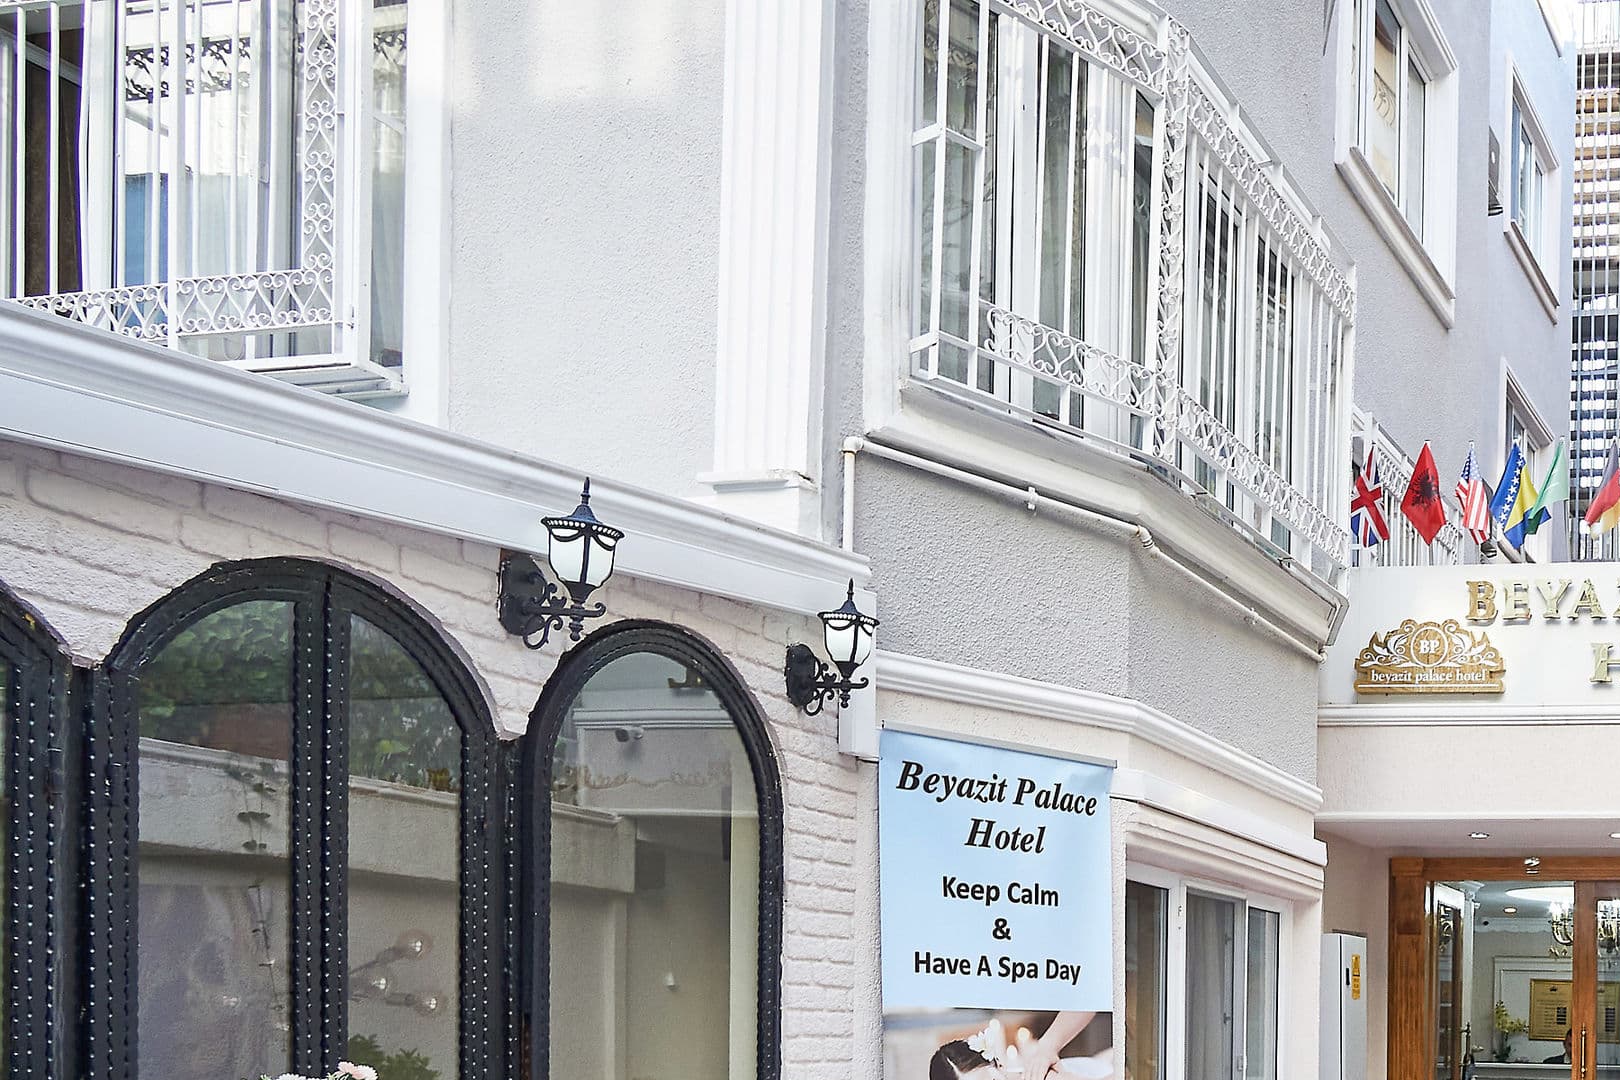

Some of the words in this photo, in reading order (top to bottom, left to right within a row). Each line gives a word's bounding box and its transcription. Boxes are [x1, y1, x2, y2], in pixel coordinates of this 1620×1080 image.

[1419, 639, 1440, 654] BP
[1371, 669, 1412, 683] beyazit
[1415, 669, 1453, 684] palace
[1456, 669, 1486, 682] hotel
[896, 760, 1007, 803] Beyazit
[1012, 777, 1098, 816] Palace
[964, 817, 1046, 854] Hotel
[942, 875, 1000, 906] Keep
[1007, 882, 1059, 907] Calm
[992, 917, 1012, 940] &
[914, 951, 971, 976] Have
[976, 955, 992, 977] A
[998, 956, 1039, 983] Spa
[1045, 958, 1081, 985] Day
